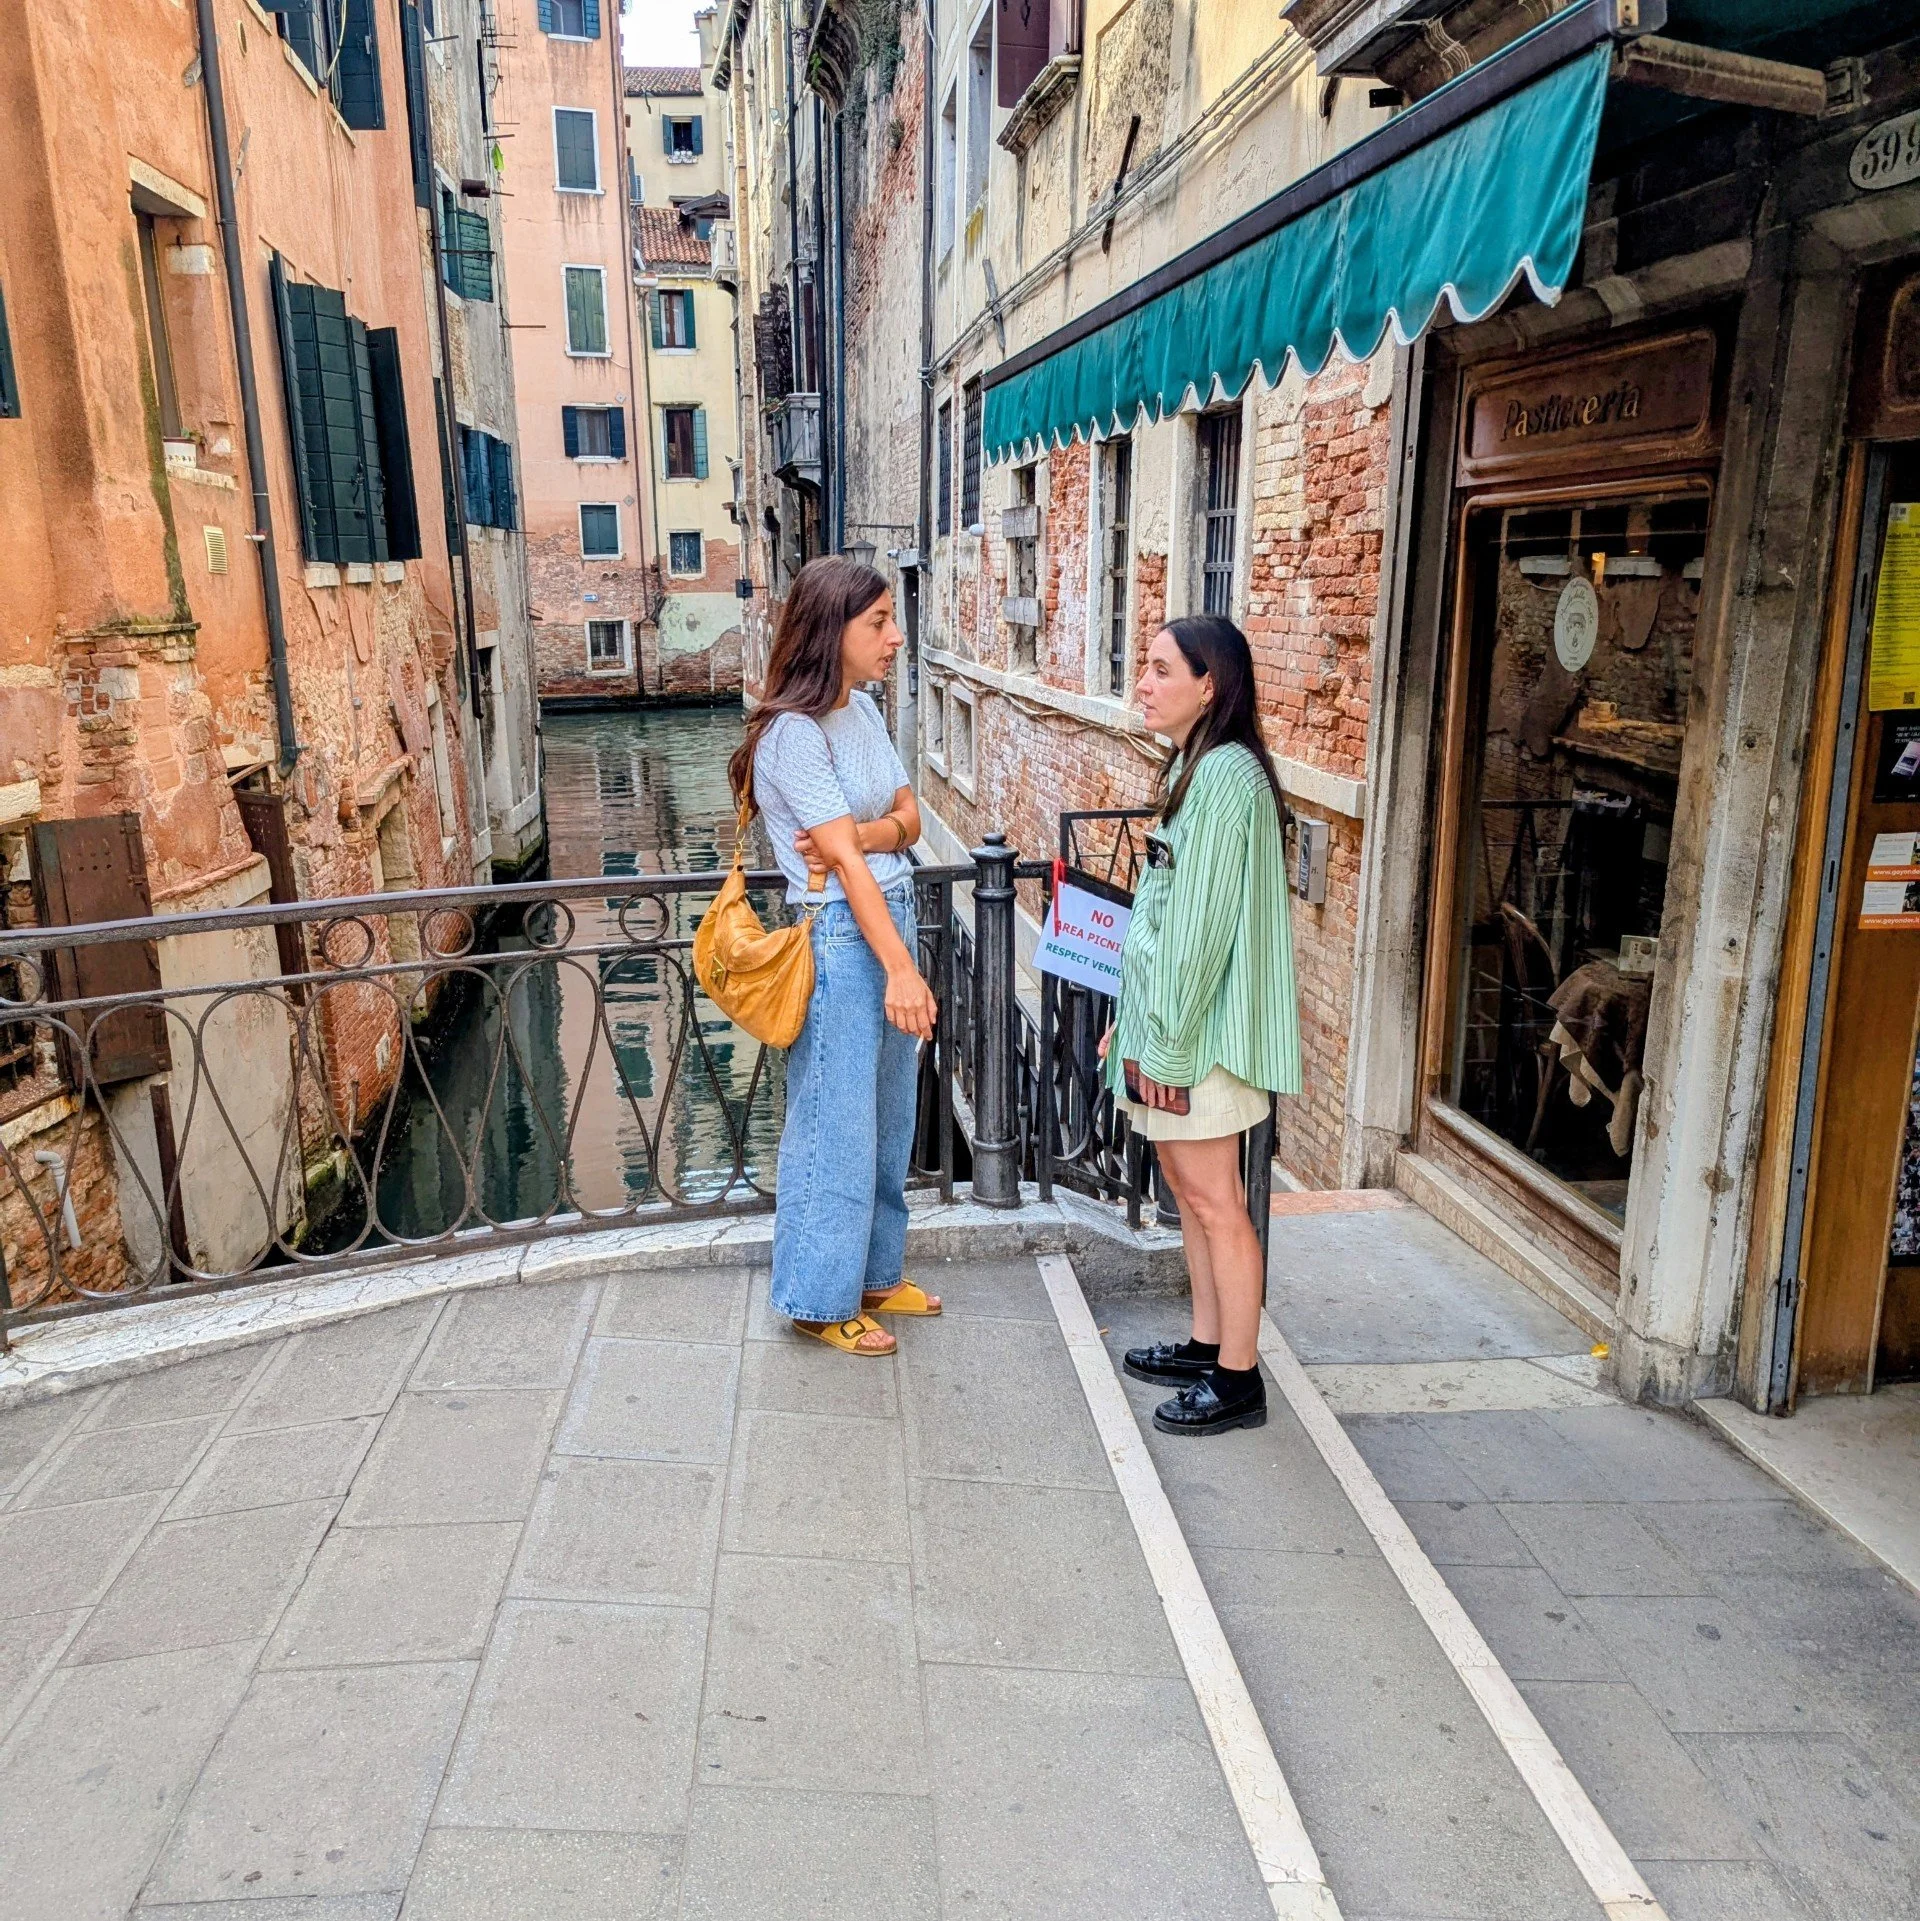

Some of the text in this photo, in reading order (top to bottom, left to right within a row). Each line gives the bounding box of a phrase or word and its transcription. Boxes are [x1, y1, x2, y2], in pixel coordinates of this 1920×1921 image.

[1501, 380, 1641, 442] Pasticceria
[1091, 910, 1114, 928] NO
[1087, 932, 1122, 953] PICNI
[1046, 942, 1122, 978] RESPECT VENIC
